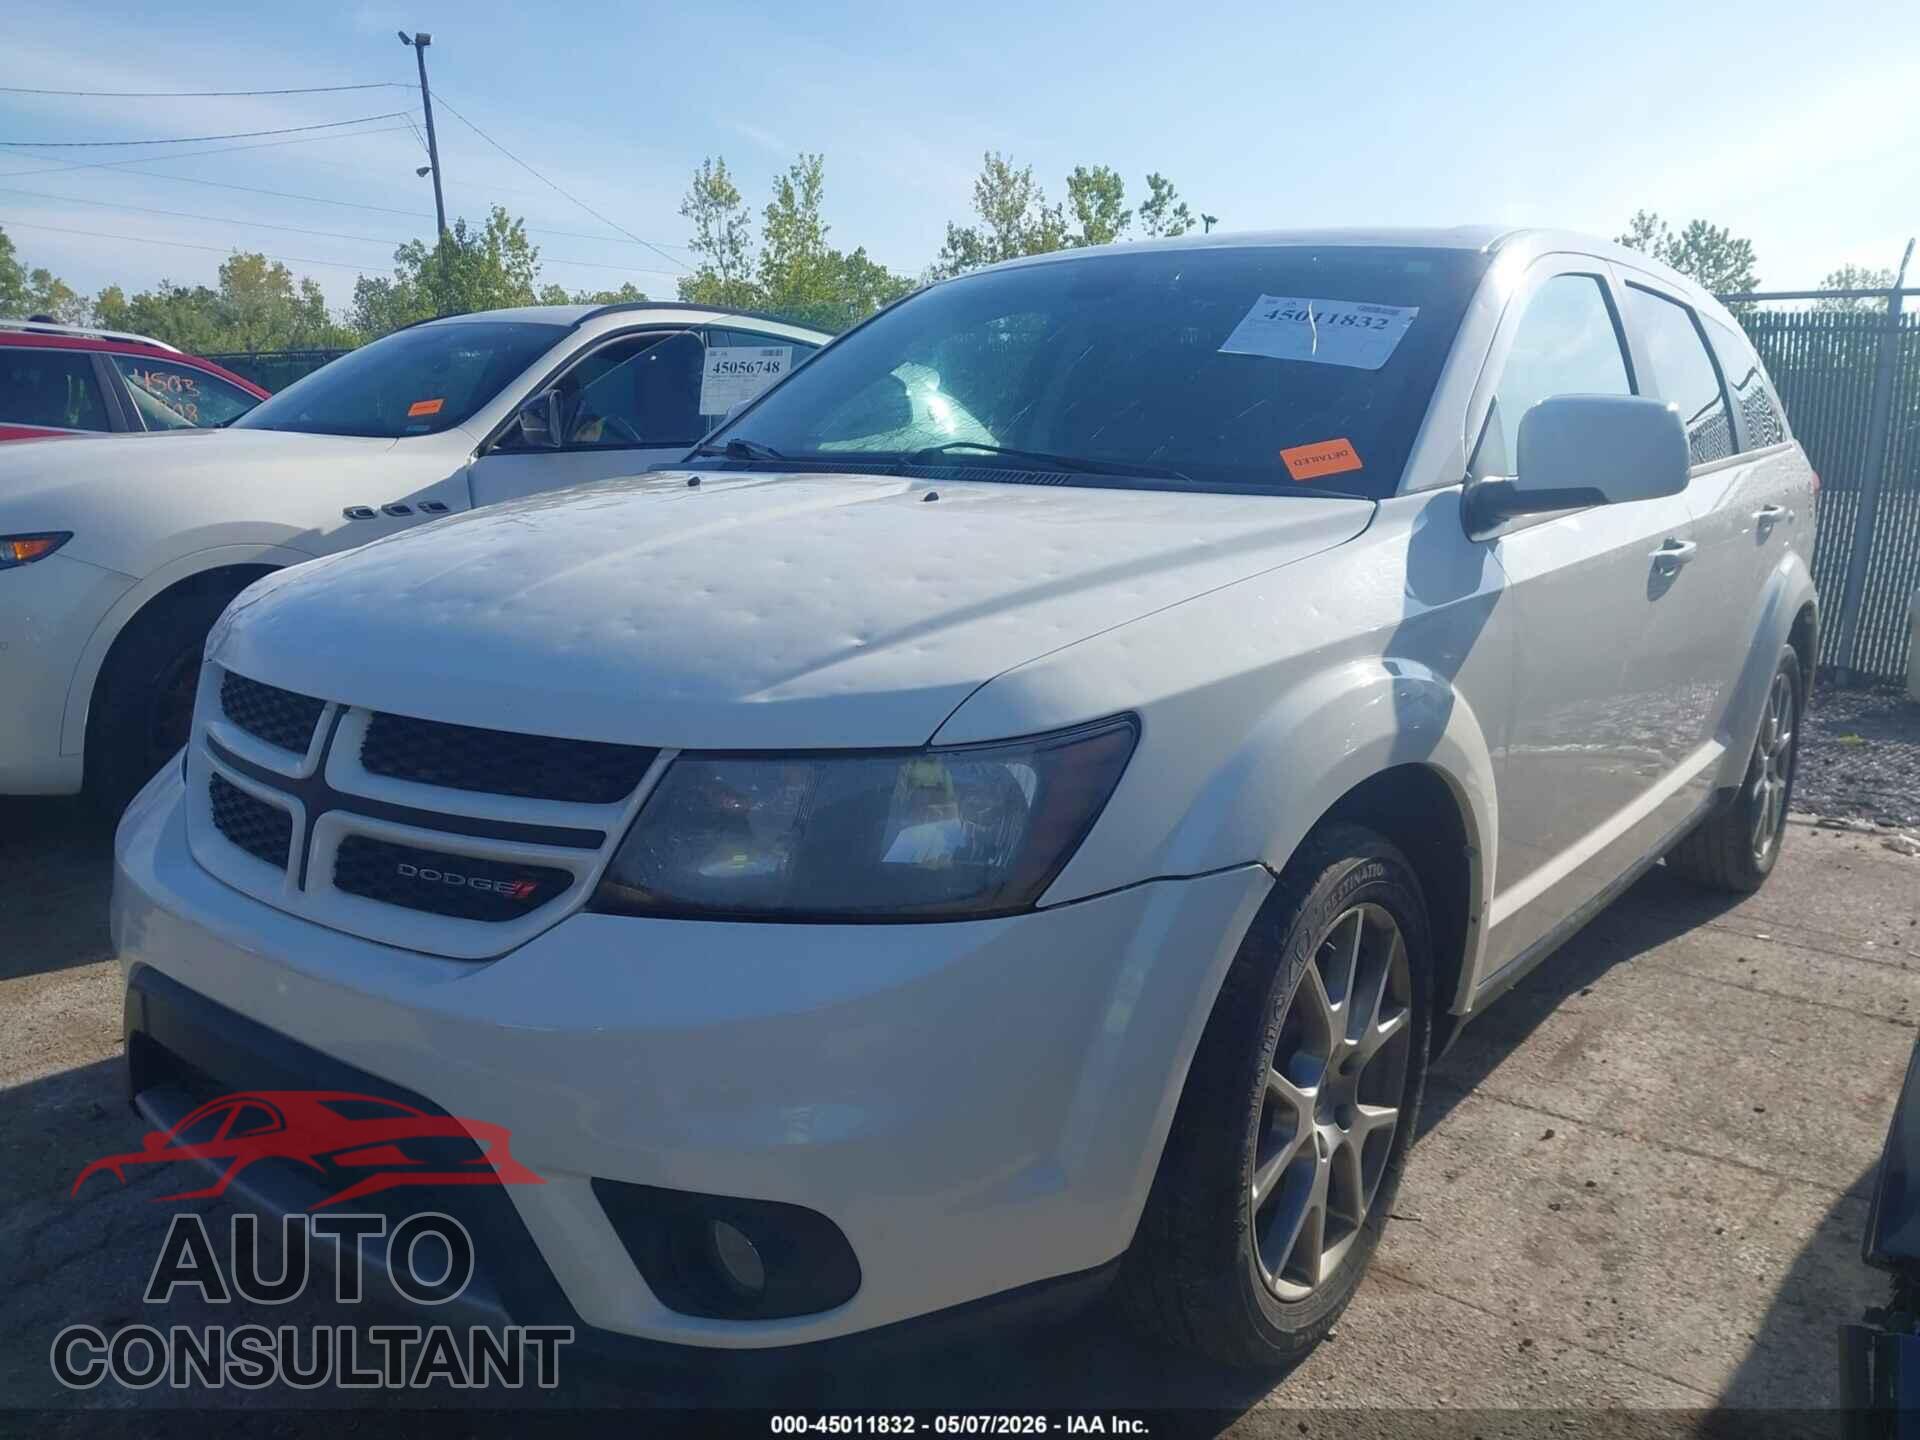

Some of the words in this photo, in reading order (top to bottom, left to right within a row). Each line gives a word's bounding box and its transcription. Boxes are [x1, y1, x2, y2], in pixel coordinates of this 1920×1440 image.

[1263, 308, 1389, 330] 45011832
[712, 360, 781, 375] 45056748
[1293, 449, 1349, 466] DETAILED
[397, 863, 517, 895] DODGE
